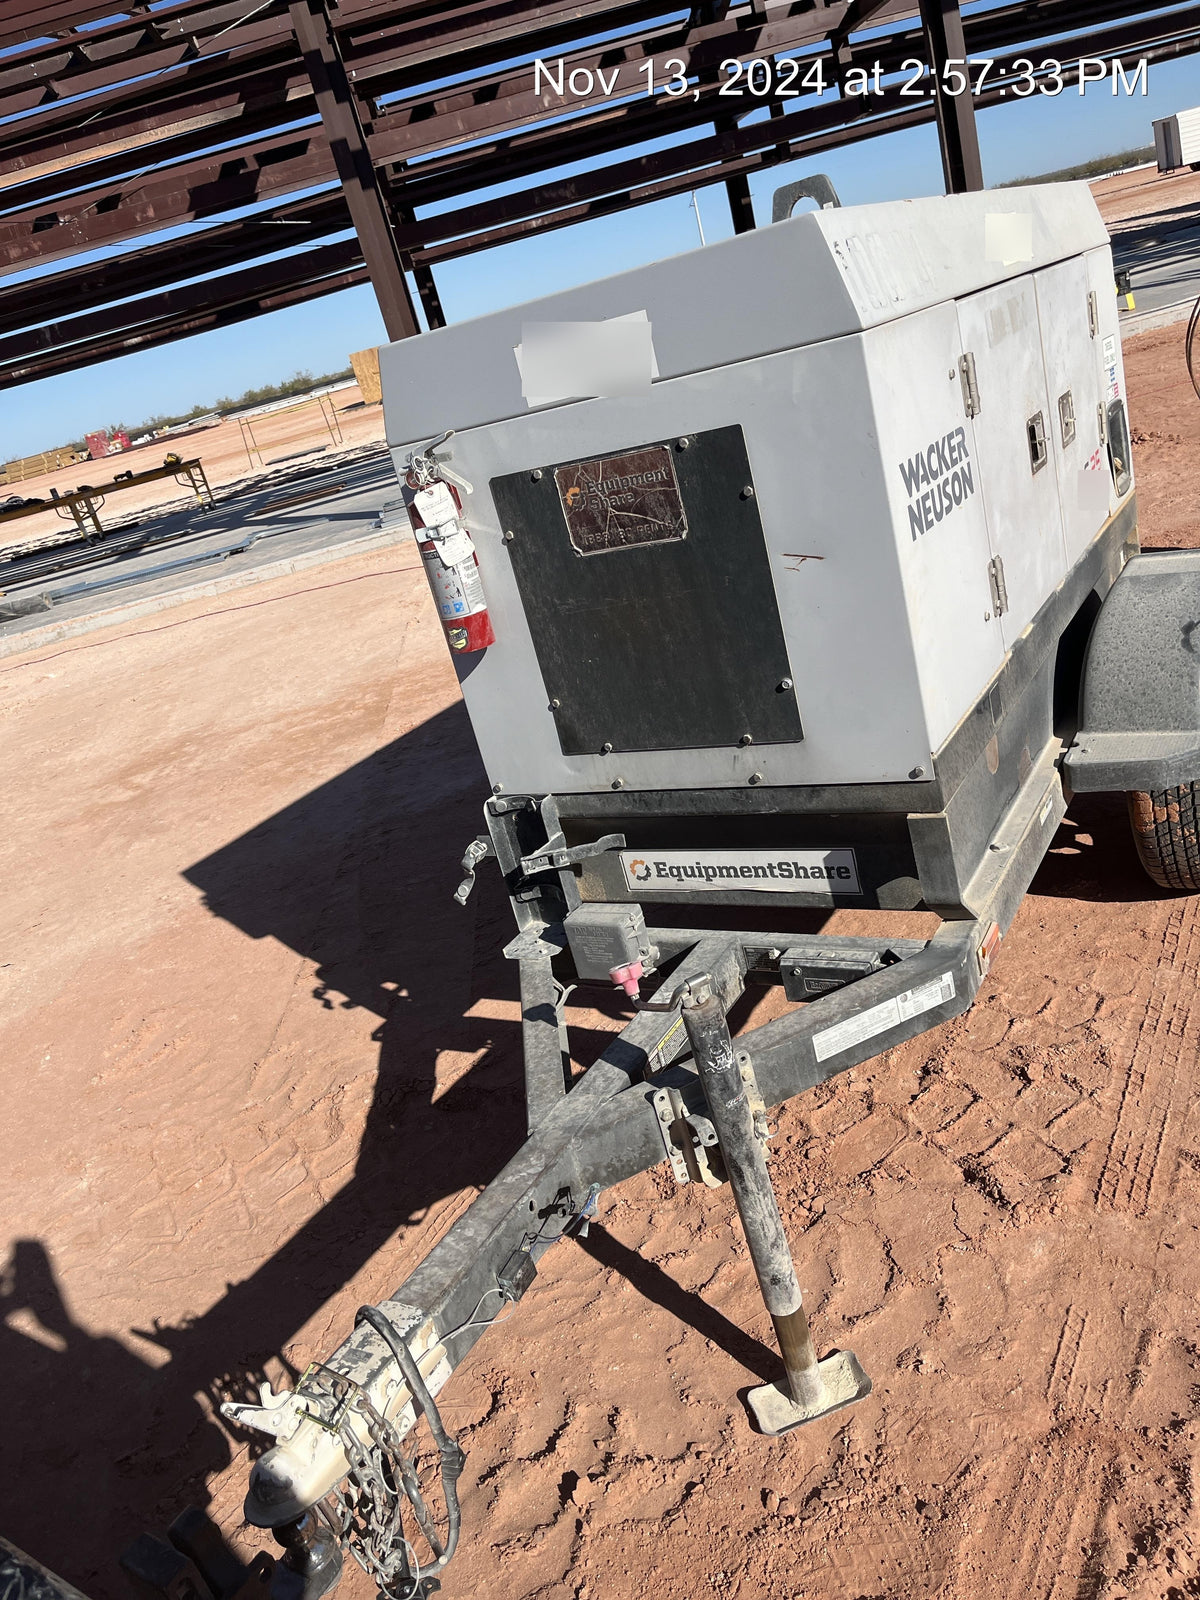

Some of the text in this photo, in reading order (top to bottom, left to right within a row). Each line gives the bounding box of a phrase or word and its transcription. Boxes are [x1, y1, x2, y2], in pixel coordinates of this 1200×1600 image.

[899, 426, 970, 498] WACKER
[586, 467, 668, 495] Equipment
[589, 492, 635, 511] Share
[907, 461, 975, 542] NEUSON
[655, 860, 851, 884] EquipmentShare
